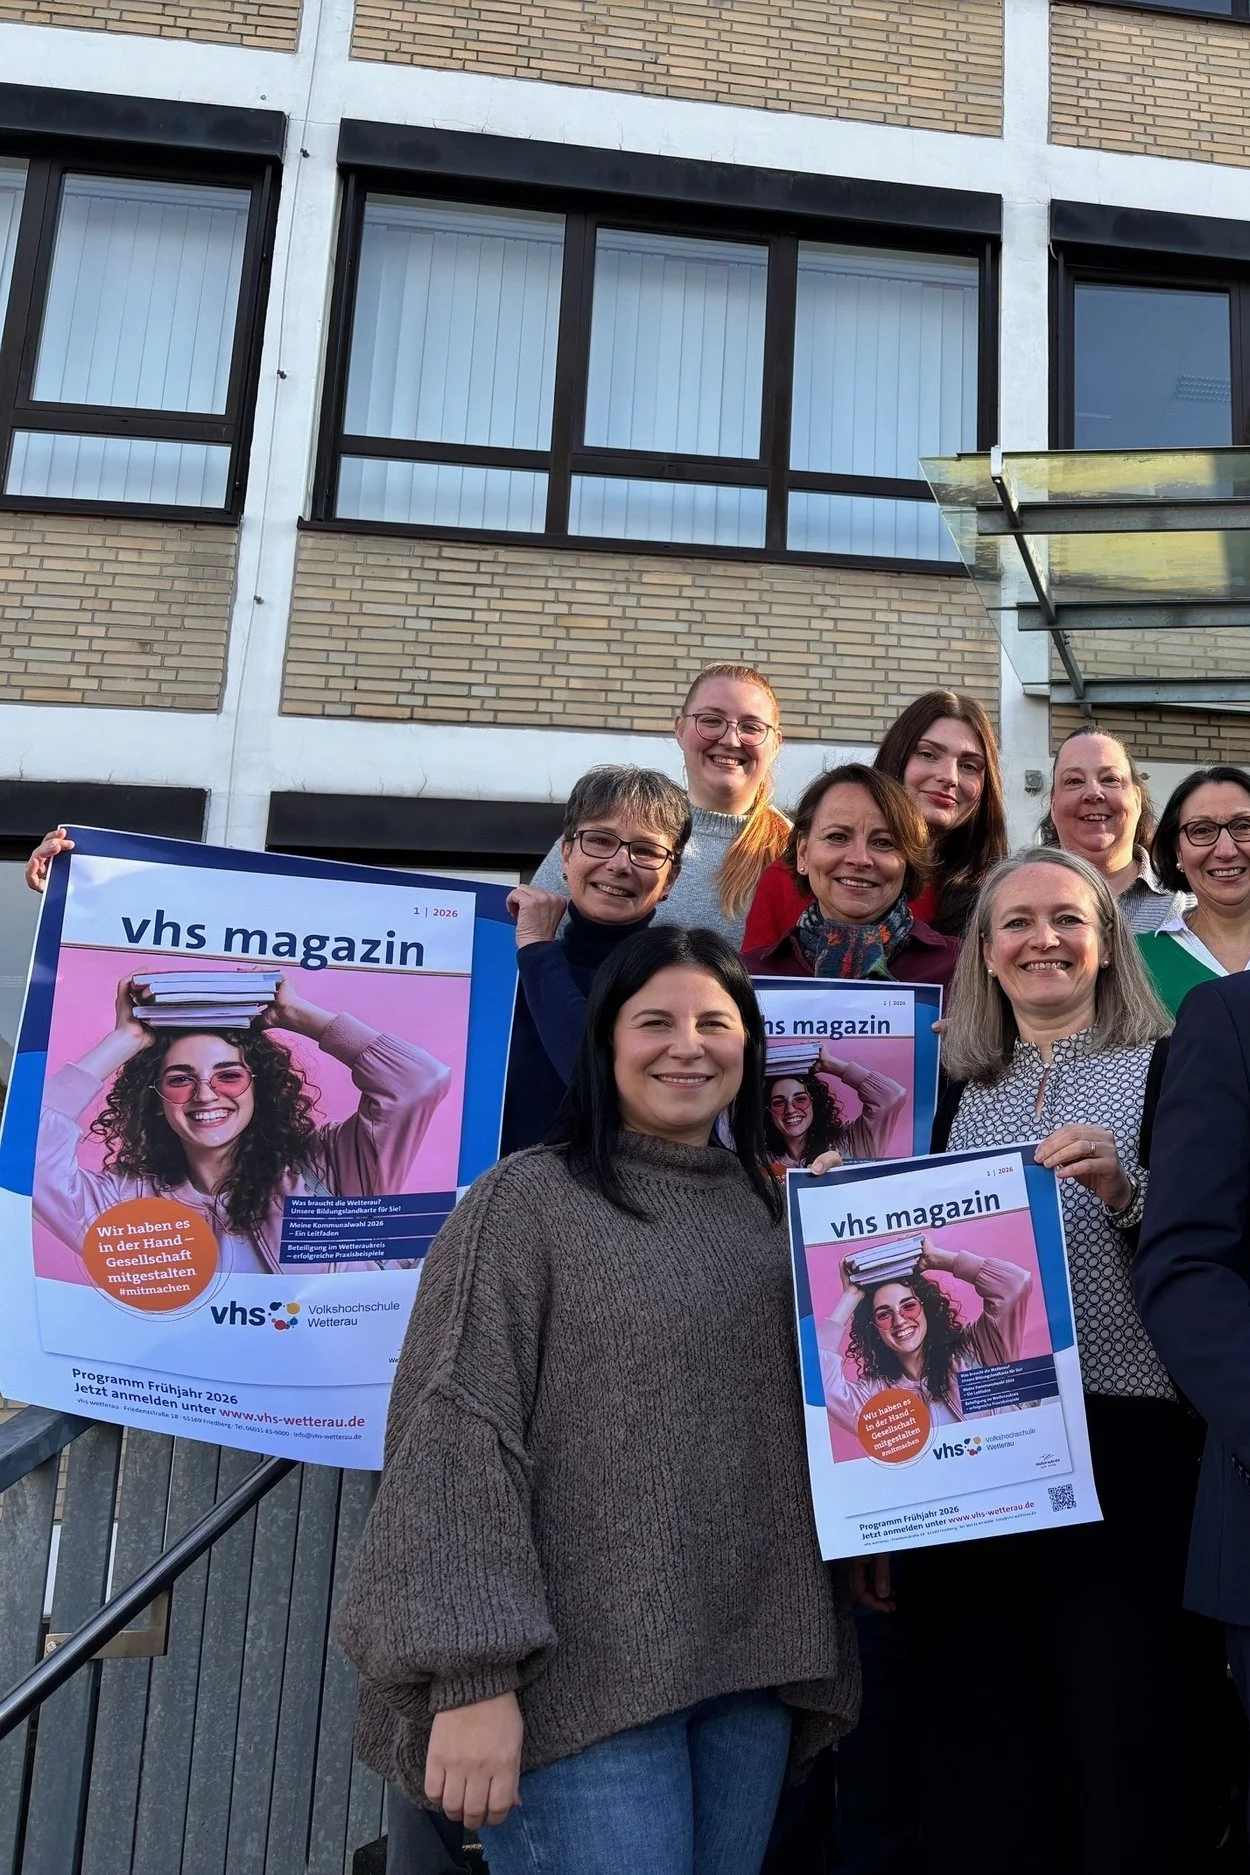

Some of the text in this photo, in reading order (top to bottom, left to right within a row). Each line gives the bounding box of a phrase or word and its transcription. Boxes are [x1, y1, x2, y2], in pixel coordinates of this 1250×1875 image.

[413, 907, 421, 915] 1
[432, 908, 459, 919] 2026
[121, 909, 424, 971] vhs magazin
[763, 1015, 891, 1041] hs magazin
[998, 1166, 1014, 1175] 2026
[316, 1207, 377, 1216] Bildungslandkarte
[388, 1205, 401, 1213] Sie!
[830, 1190, 1000, 1238] vhs magazin
[96, 1220, 191, 1238] Wir haben es
[313, 1221, 366, 1229] Kommunalwahl
[98, 1242, 114, 1253] in
[117, 1241, 140, 1252] der
[143, 1236, 182, 1249] Hand
[287, 1244, 327, 1253] Beteiligung
[339, 1242, 385, 1251] Wetteraukreis
[106, 1249, 193, 1268] Gesellschaft
[293, 1250, 385, 1261] erfolgreiche Praxisbeispiele
[107, 1267, 197, 1284] mitgestalten
[119, 1284, 191, 1296] #mitmachen
[210, 1301, 266, 1326] vhs
[308, 1301, 400, 1315] Volkshochschule
[307, 1317, 358, 1328] Wetterau
[72, 1368, 238, 1405] Programm Frühjahr 2026
[74, 1382, 365, 1428] Jetzt anmelden unter www.vhs-wetterau.de
[863, 1398, 912, 1422] Wir haben es
[865, 1408, 910, 1432] in der Hand
[871, 1417, 917, 1440] Gesellschaft
[873, 1427, 921, 1451] mitgestalten
[985, 1428, 1036, 1443] Volkshochschule
[882, 1438, 920, 1457] #mitmachen
[933, 1442, 964, 1460] vhs
[859, 1505, 959, 1531] Programm Frühjahr 2026
[862, 1531, 881, 1541] Jetzt
[883, 1523, 924, 1536] anmelden
[925, 1518, 947, 1529] unter
[948, 1501, 1035, 1524] www.vhs-wetterau.de
